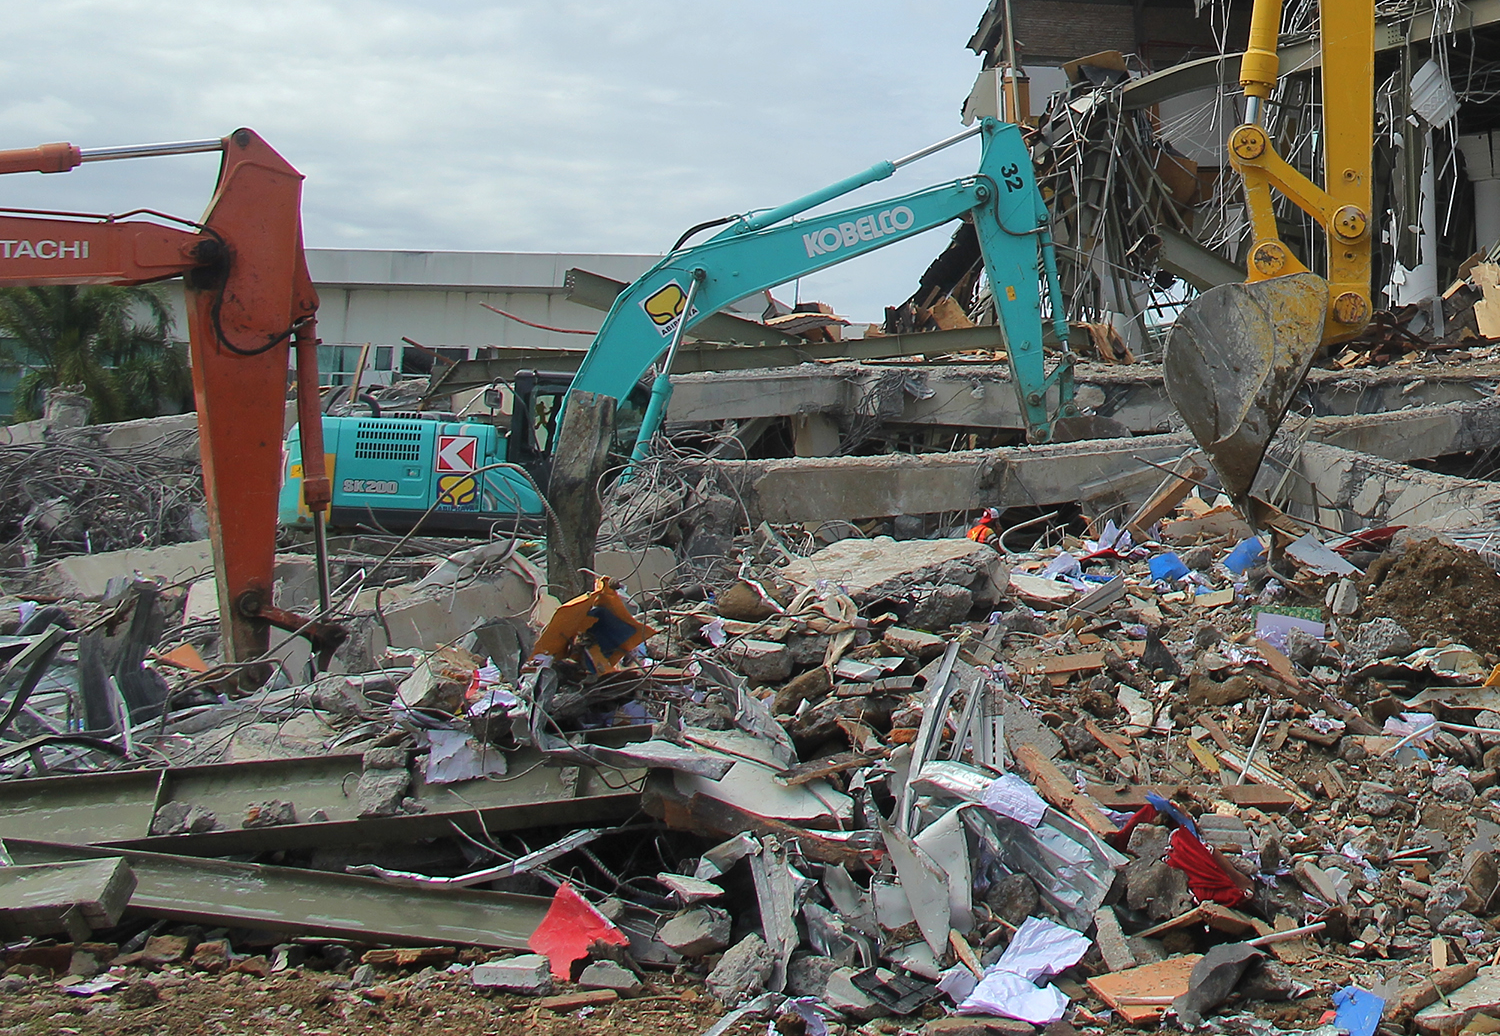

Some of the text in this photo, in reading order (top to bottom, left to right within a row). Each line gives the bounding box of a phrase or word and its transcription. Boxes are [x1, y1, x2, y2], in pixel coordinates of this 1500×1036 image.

[1001, 163, 1024, 193] 32
[802, 206, 915, 258] KOBELCO
[0, 239, 89, 259] TACHI
[661, 308, 698, 336] ABIPA
